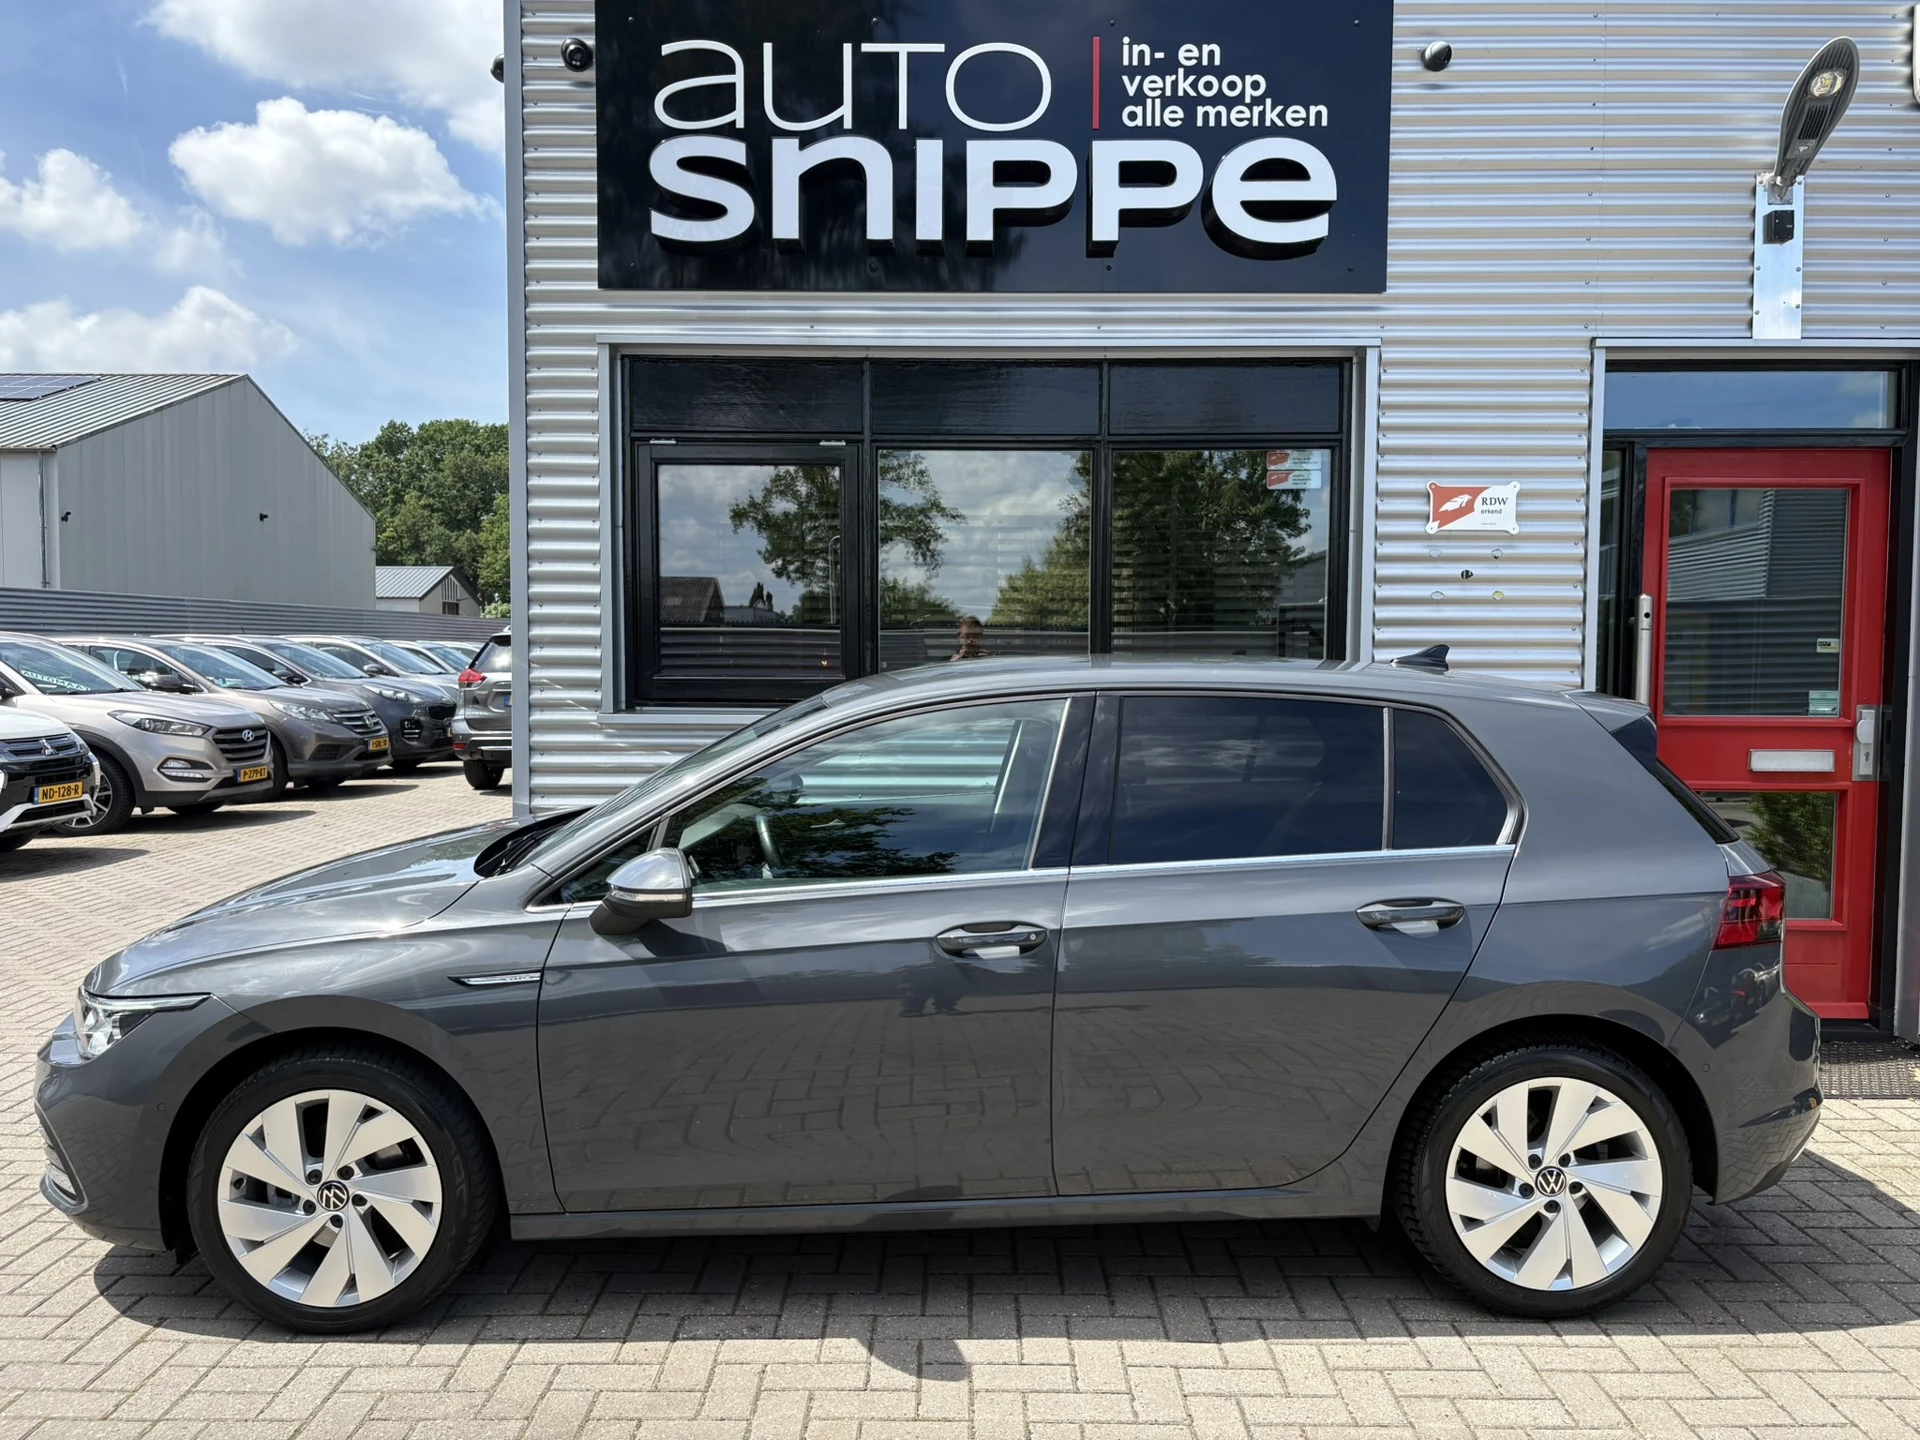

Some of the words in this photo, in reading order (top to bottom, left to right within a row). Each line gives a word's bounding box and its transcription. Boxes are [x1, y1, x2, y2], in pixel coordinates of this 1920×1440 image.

[1122, 36, 1165, 66] in-
[1178, 43, 1221, 66] en
[1121, 67, 1267, 103] verkoop
[1121, 98, 1185, 127] alle
[1196, 98, 1328, 127] merken
[1481, 496, 1508, 506] RDW
[41, 784, 80, 801] ND-128-R
